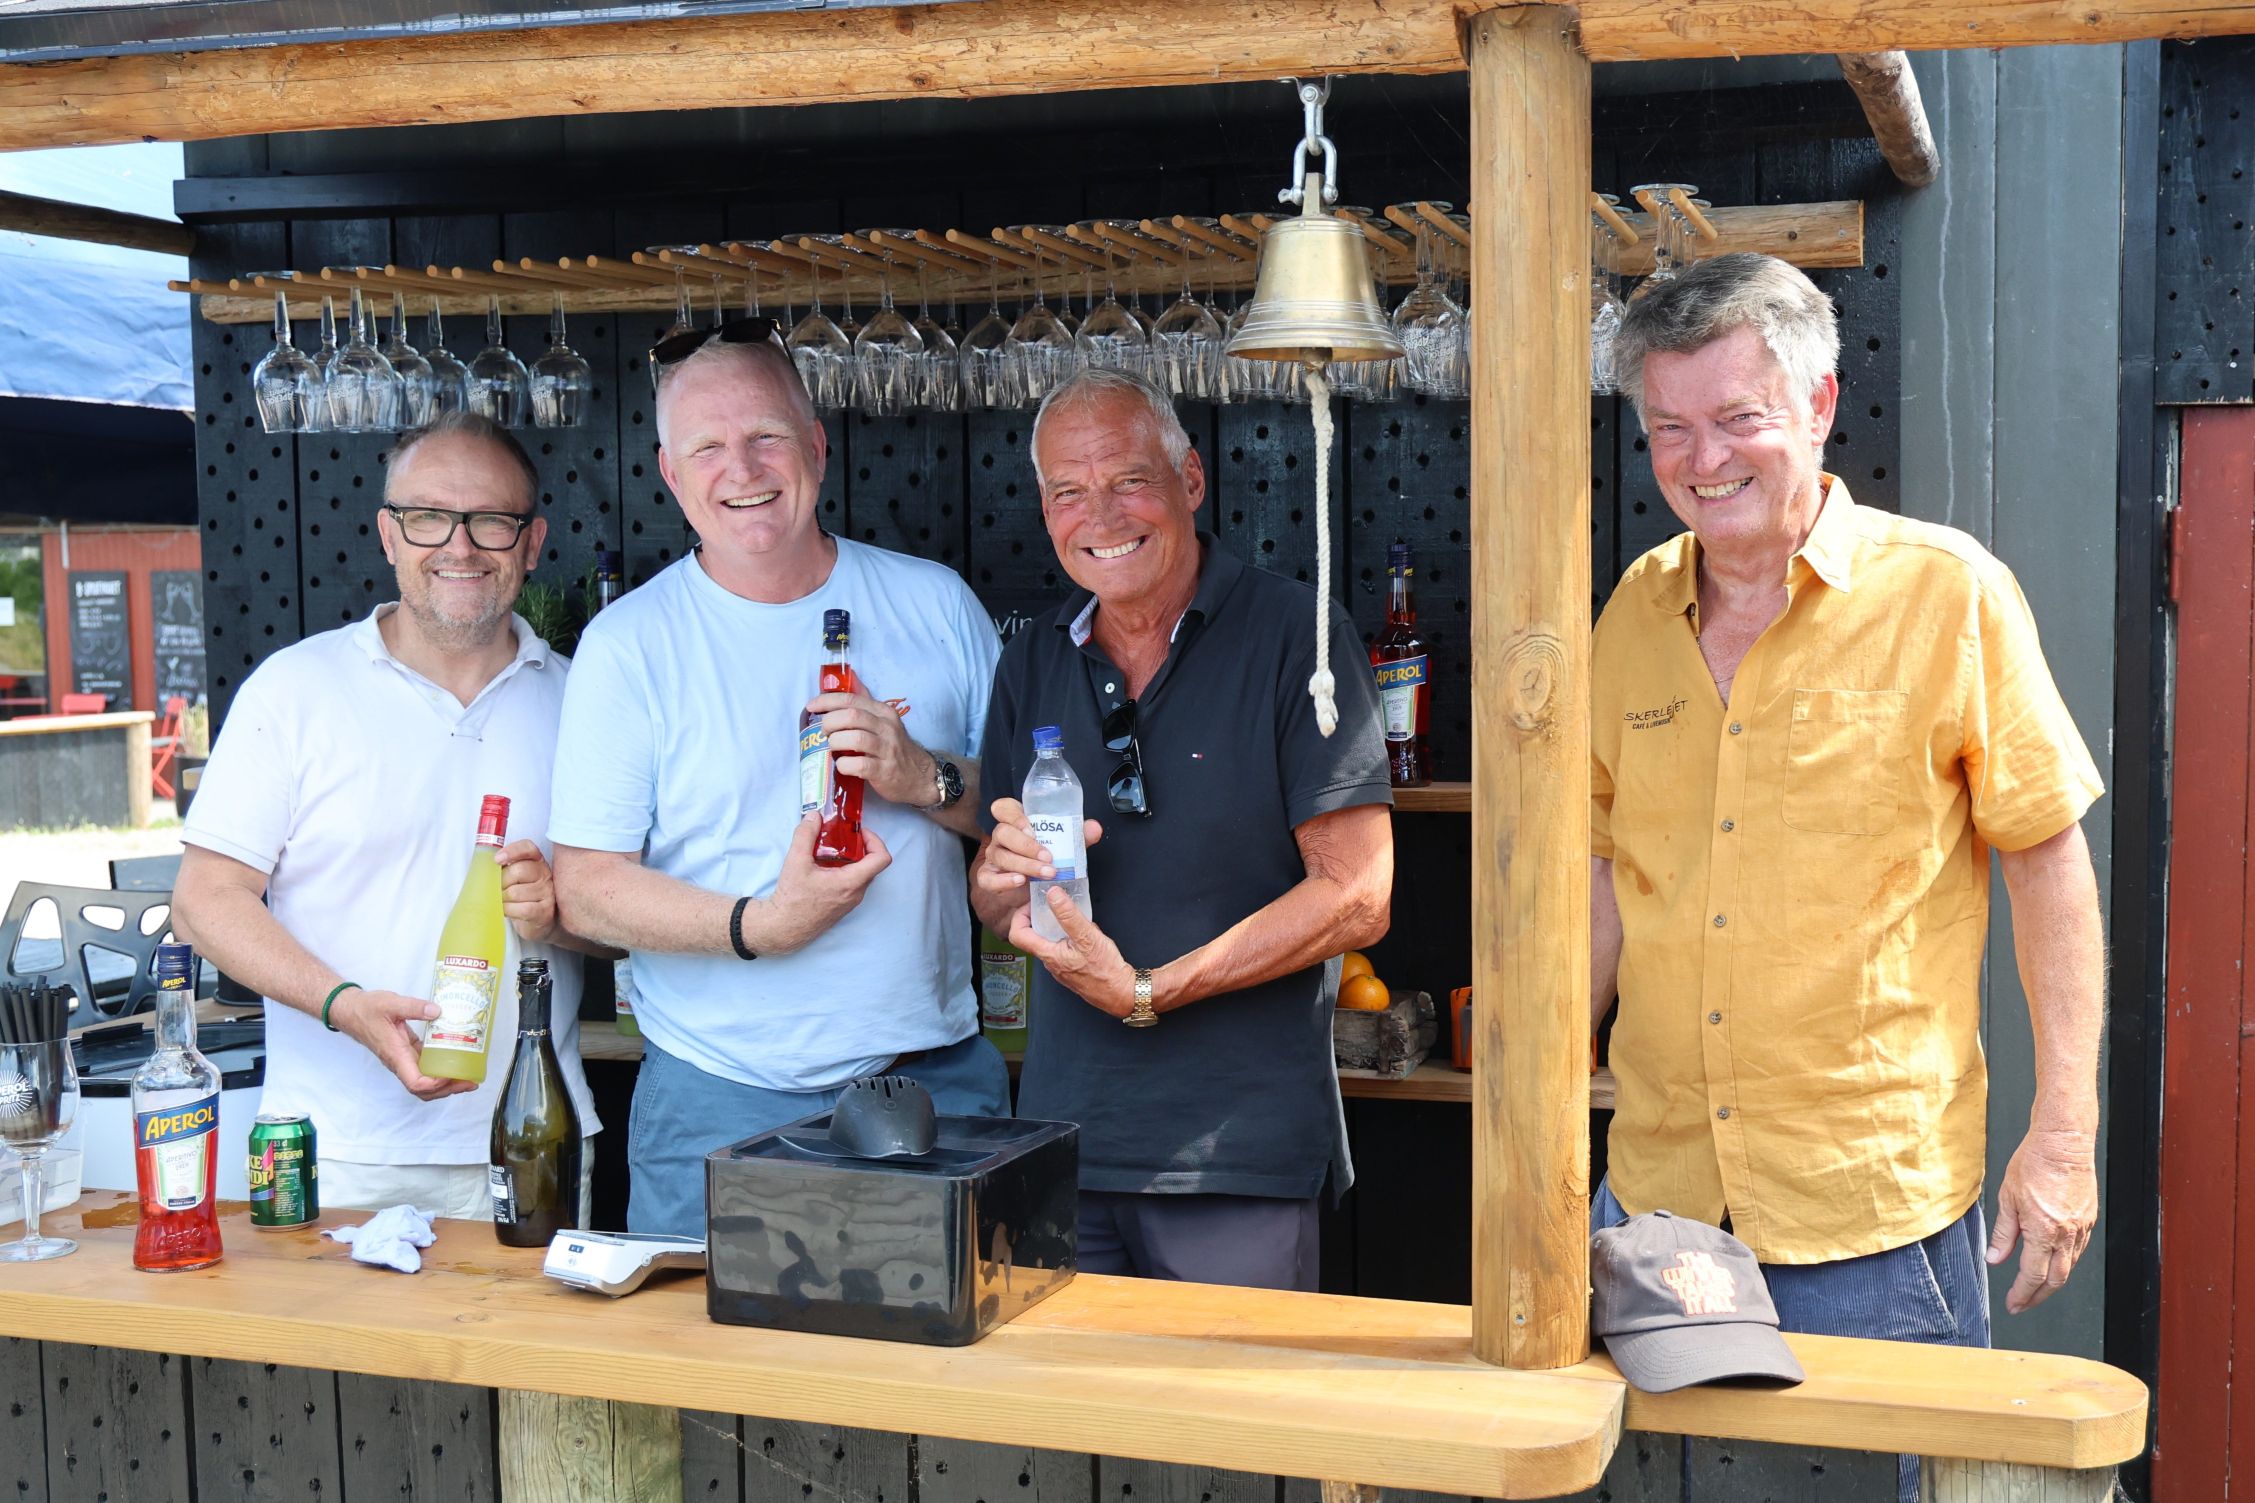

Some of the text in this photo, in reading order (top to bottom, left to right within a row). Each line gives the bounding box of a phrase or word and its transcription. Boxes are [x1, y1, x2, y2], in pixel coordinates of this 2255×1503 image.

[1376, 664, 1422, 686] APEROL
[1030, 820, 1064, 832] MLÖSA
[445, 957, 486, 969] LUXARDO
[162, 976, 186, 988] APEROL
[145, 1105, 215, 1141] APEROL
